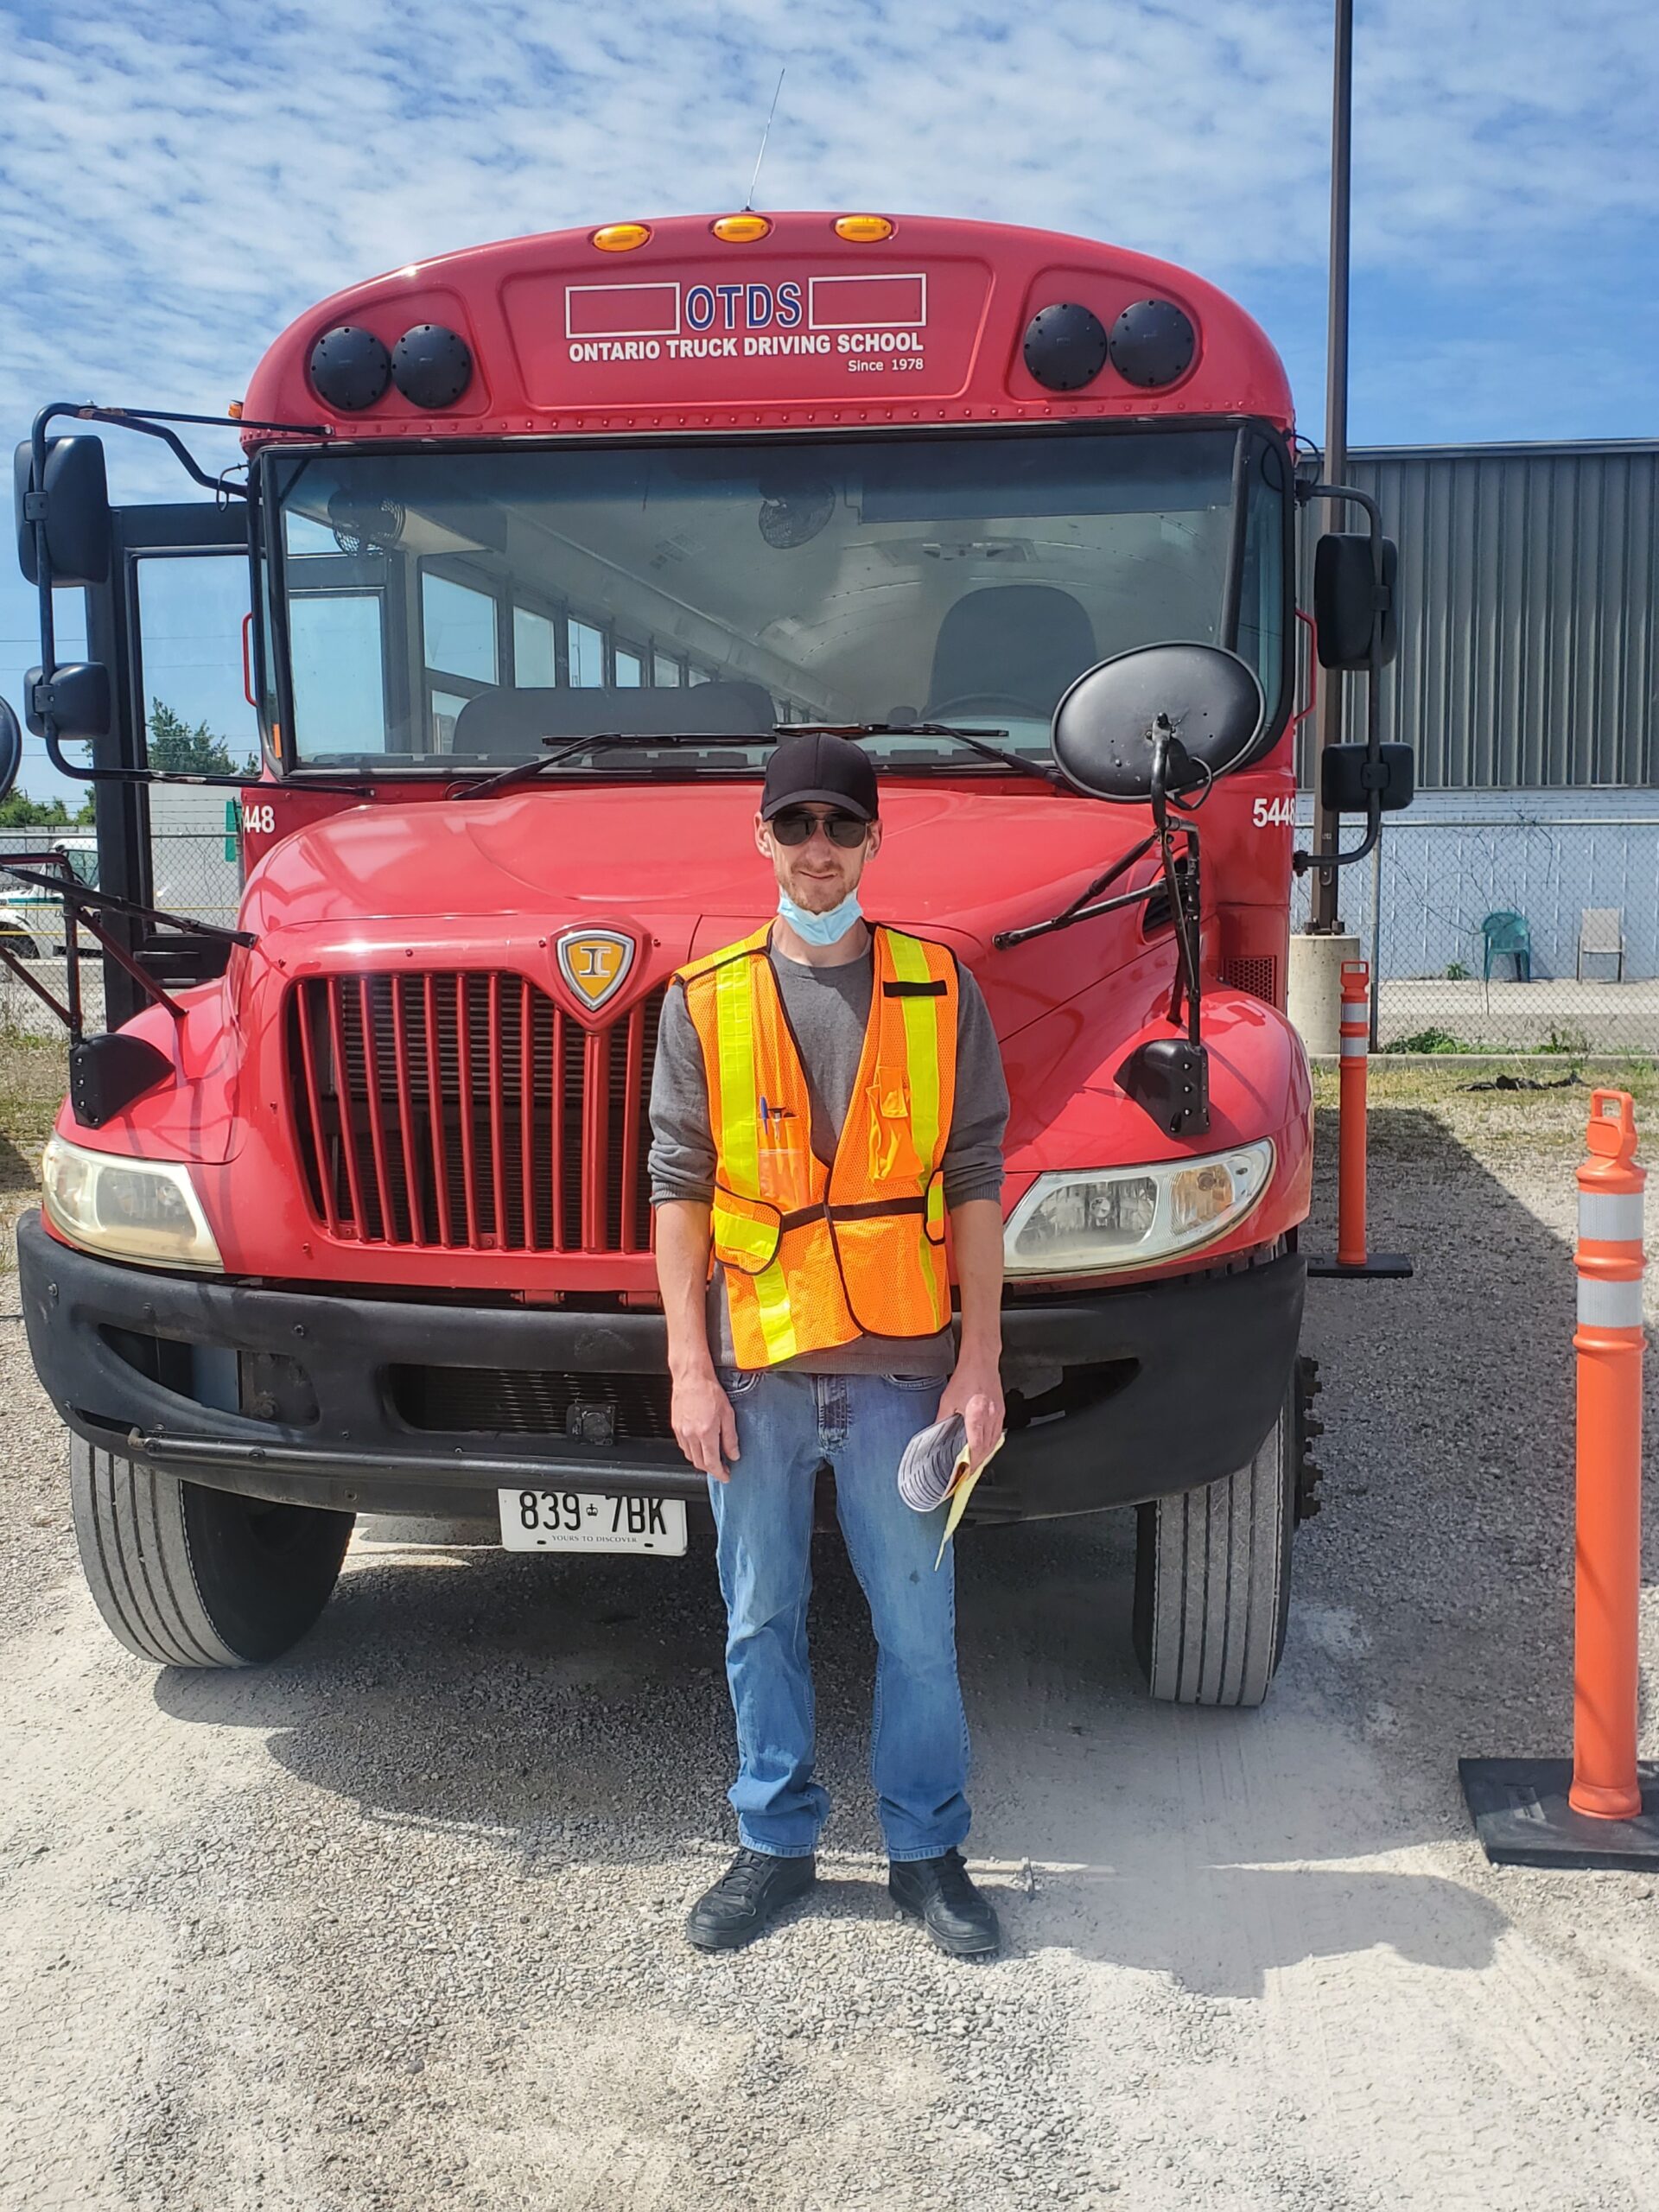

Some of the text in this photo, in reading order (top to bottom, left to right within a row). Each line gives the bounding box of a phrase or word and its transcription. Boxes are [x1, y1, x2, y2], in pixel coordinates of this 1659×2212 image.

[685, 282, 802, 330] OTDS
[569, 332, 924, 362] ONTARIO TRUCK DRIVING SCHOOL
[848, 358, 924, 372] Since 1978
[243, 805, 275, 833] 448
[519, 1491, 667, 1535] 839 7BK
